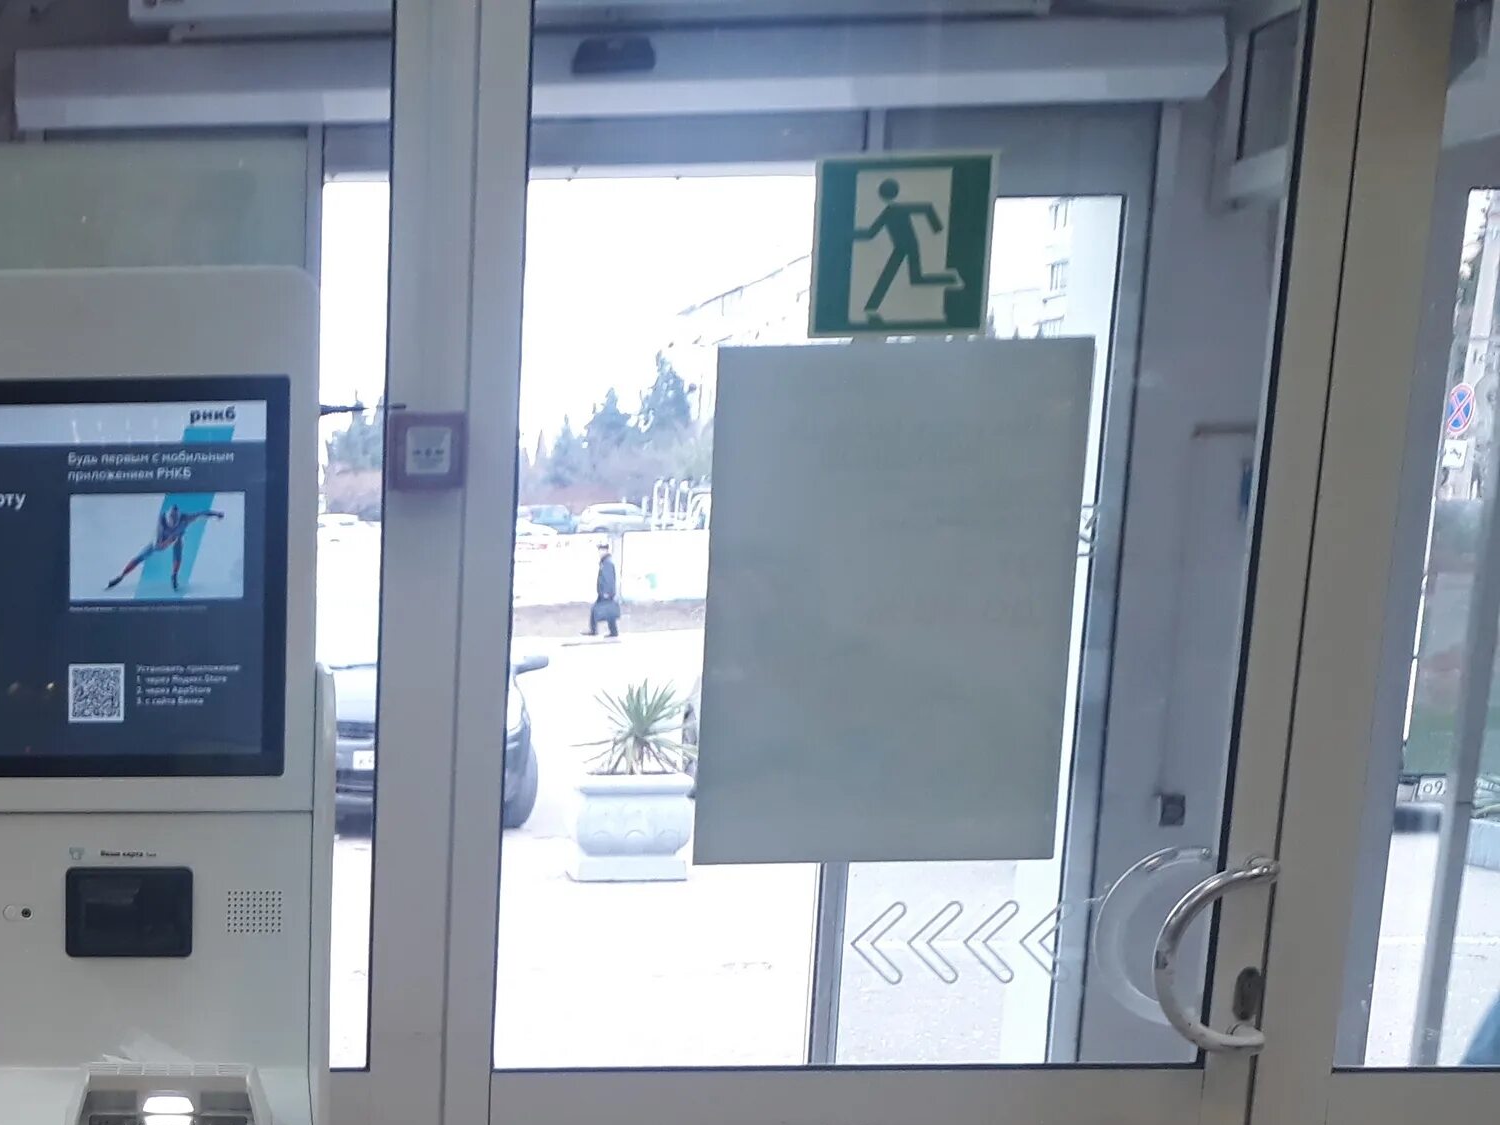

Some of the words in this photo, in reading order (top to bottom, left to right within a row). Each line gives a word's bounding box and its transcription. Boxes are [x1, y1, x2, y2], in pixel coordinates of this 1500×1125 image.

[190, 406, 236, 424] рнкб
[68, 452, 98, 466] Будь
[156, 467, 192, 479] РНКБ
